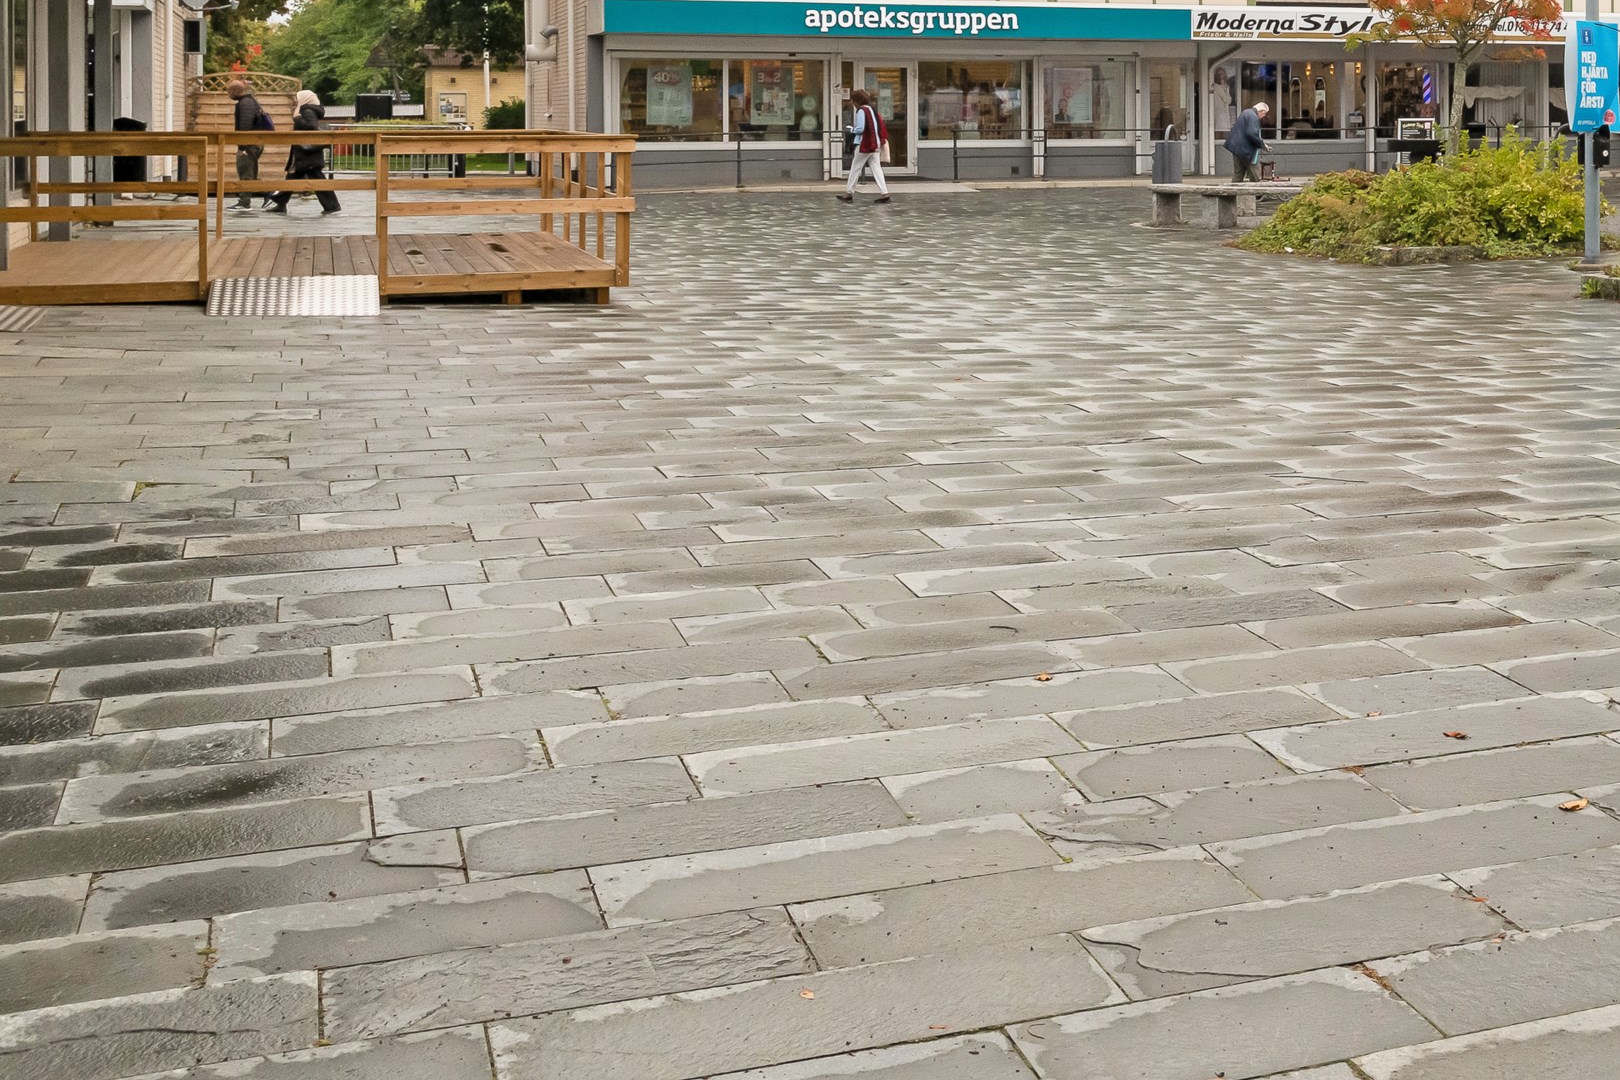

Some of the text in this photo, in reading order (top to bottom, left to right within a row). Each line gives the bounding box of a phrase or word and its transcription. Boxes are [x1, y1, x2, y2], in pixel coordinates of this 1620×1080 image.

[804, 5, 1019, 35] apoteksgruppen
[1195, 12, 1386, 37] Moderna Styl
[653, 71, 680, 83] 40%
[757, 71, 765, 83] 3
[773, 71, 781, 83] 2
[1581, 63, 1609, 80] HJÄRTA
[1581, 77, 1597, 94] FÖR
